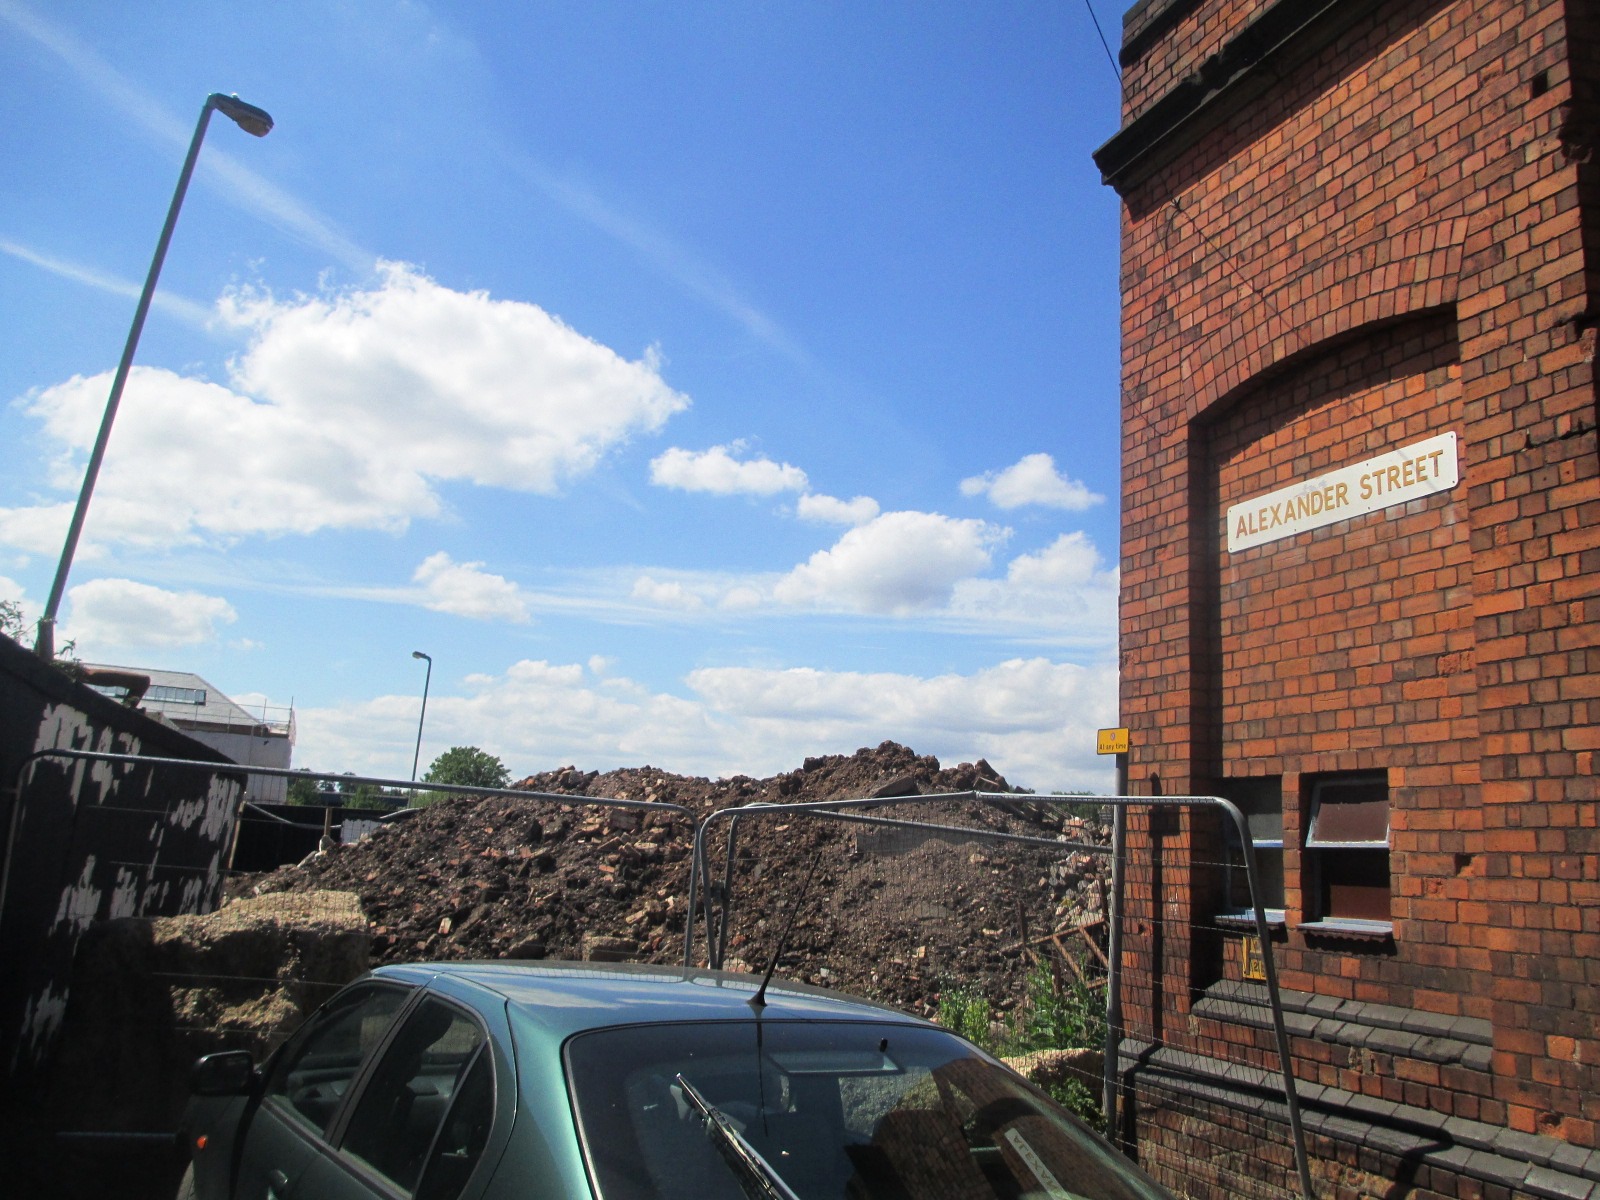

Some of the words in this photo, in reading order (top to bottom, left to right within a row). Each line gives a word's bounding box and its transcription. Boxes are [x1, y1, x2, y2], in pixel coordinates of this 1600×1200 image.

[1235, 481, 1349, 539] ALEXANDER
[1359, 449, 1443, 500] STREET
[1115, 742, 1127, 750] time
